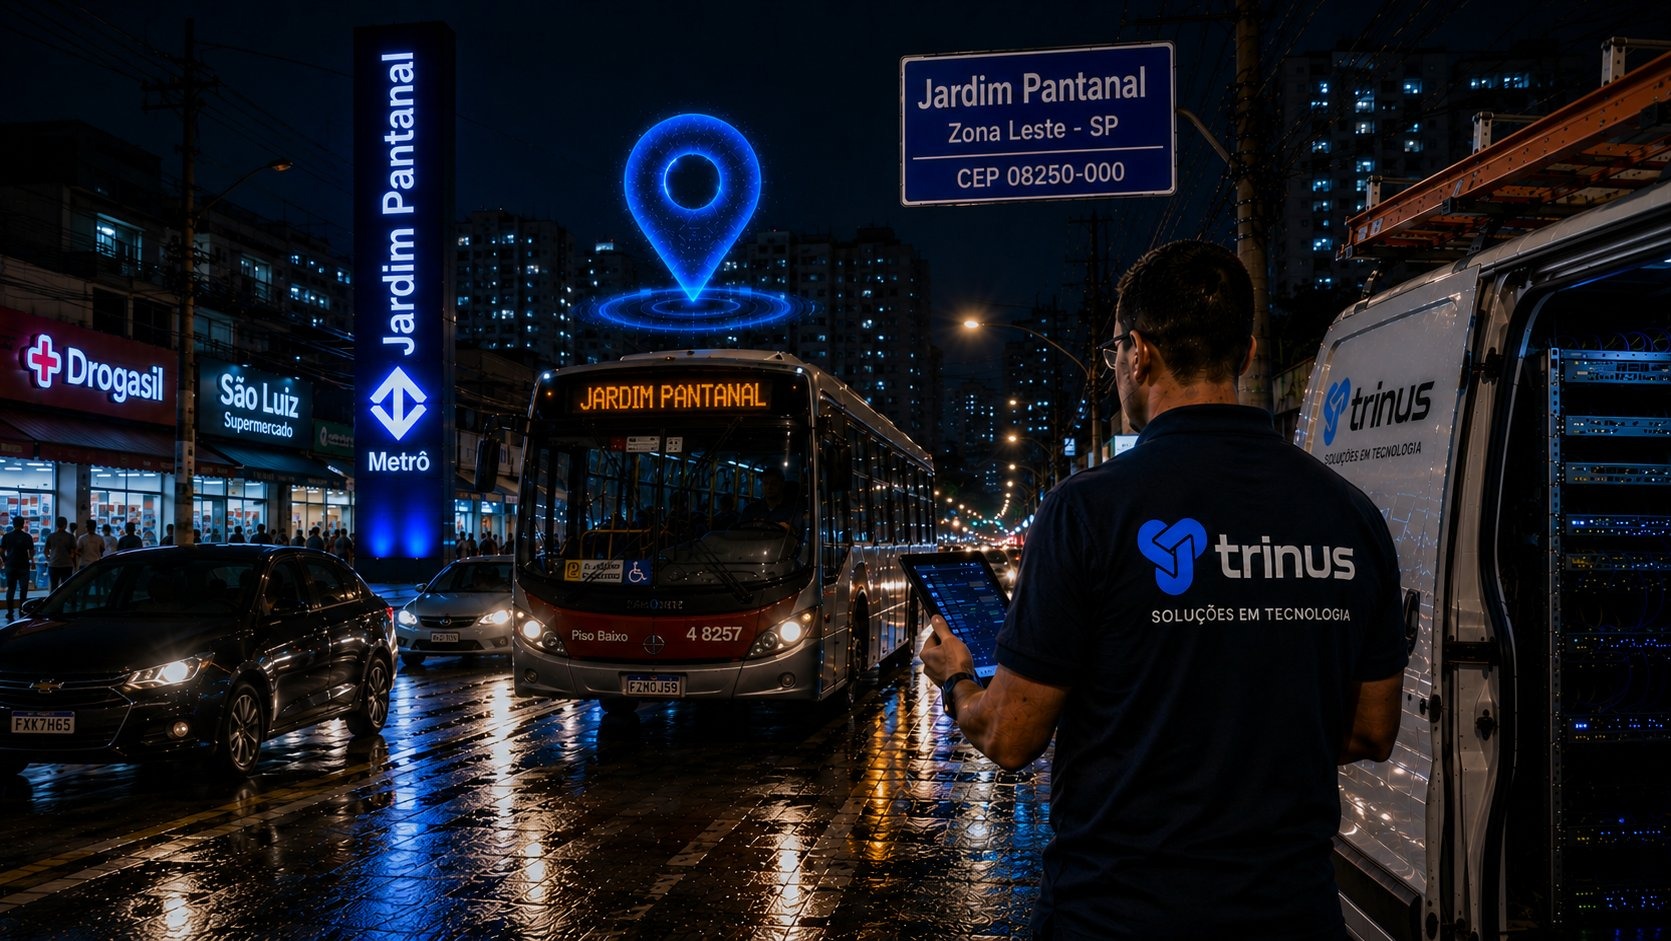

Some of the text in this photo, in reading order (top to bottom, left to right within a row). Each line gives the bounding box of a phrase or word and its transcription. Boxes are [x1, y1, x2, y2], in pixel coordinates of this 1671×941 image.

[917, 65, 1146, 110] Jardim Pantanal
[948, 122, 1001, 144] Zona
[1009, 118, 1066, 141] Leste
[1090, 115, 1119, 137] SP
[957, 161, 1125, 189] CEP 08250-000
[381, 52, 415, 356] Jardim Pantanal
[67, 347, 163, 403] Drogasil
[220, 372, 299, 419] São Luiz
[579, 382, 767, 411] JARDIM PANTANAL
[1349, 380, 1435, 432] trinus
[224, 411, 293, 438] Supermercado
[368, 450, 430, 472] Metrô
[1324, 441, 1422, 466] SOLUÇÕES EM TECNOLOGIA
[1214, 533, 1356, 581] trinus
[1151, 604, 1351, 625] SOLUÇÕES EM TECNOLOGIA
[571, 629, 629, 642] Piso Baixo
[686, 626, 743, 642] 4 8257
[15, 718, 71, 731] FXK7H65
